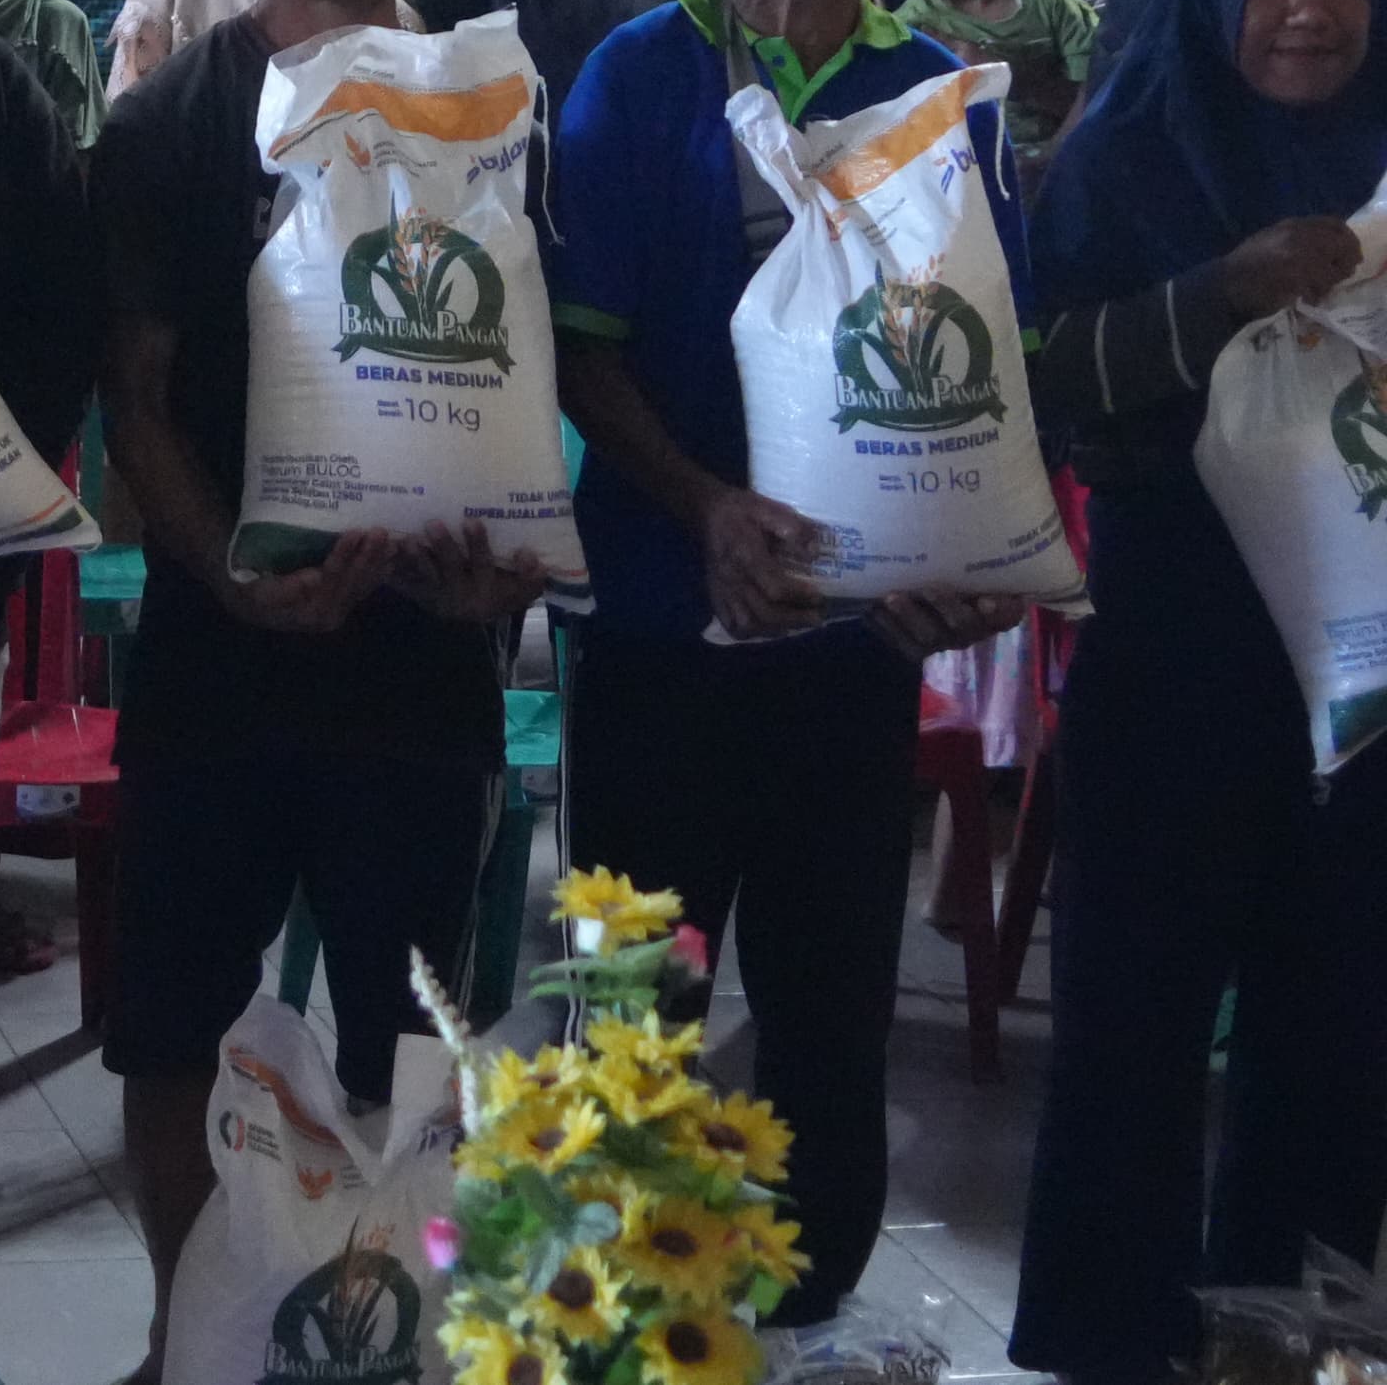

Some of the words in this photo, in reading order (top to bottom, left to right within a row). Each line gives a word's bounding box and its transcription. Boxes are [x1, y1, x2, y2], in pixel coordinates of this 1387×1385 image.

[339, 302, 435, 340] BANTUAN
[435, 309, 508, 347] PANGAN
[355, 365, 422, 383] BERAS
[428, 371, 503, 389] MEDIUM
[834, 373, 932, 411] BANTUAN
[930, 374, 1001, 410] PANGAN
[404, 398, 438, 423] 10
[447, 402, 481, 431] kg
[855, 439, 923, 456] BERAS
[928, 428, 1000, 456] MEDIUM
[306, 463, 362, 478] BULOG
[907, 470, 940, 494] 10
[948, 466, 981, 493] kg
[508, 491, 544, 503] TIDAK
